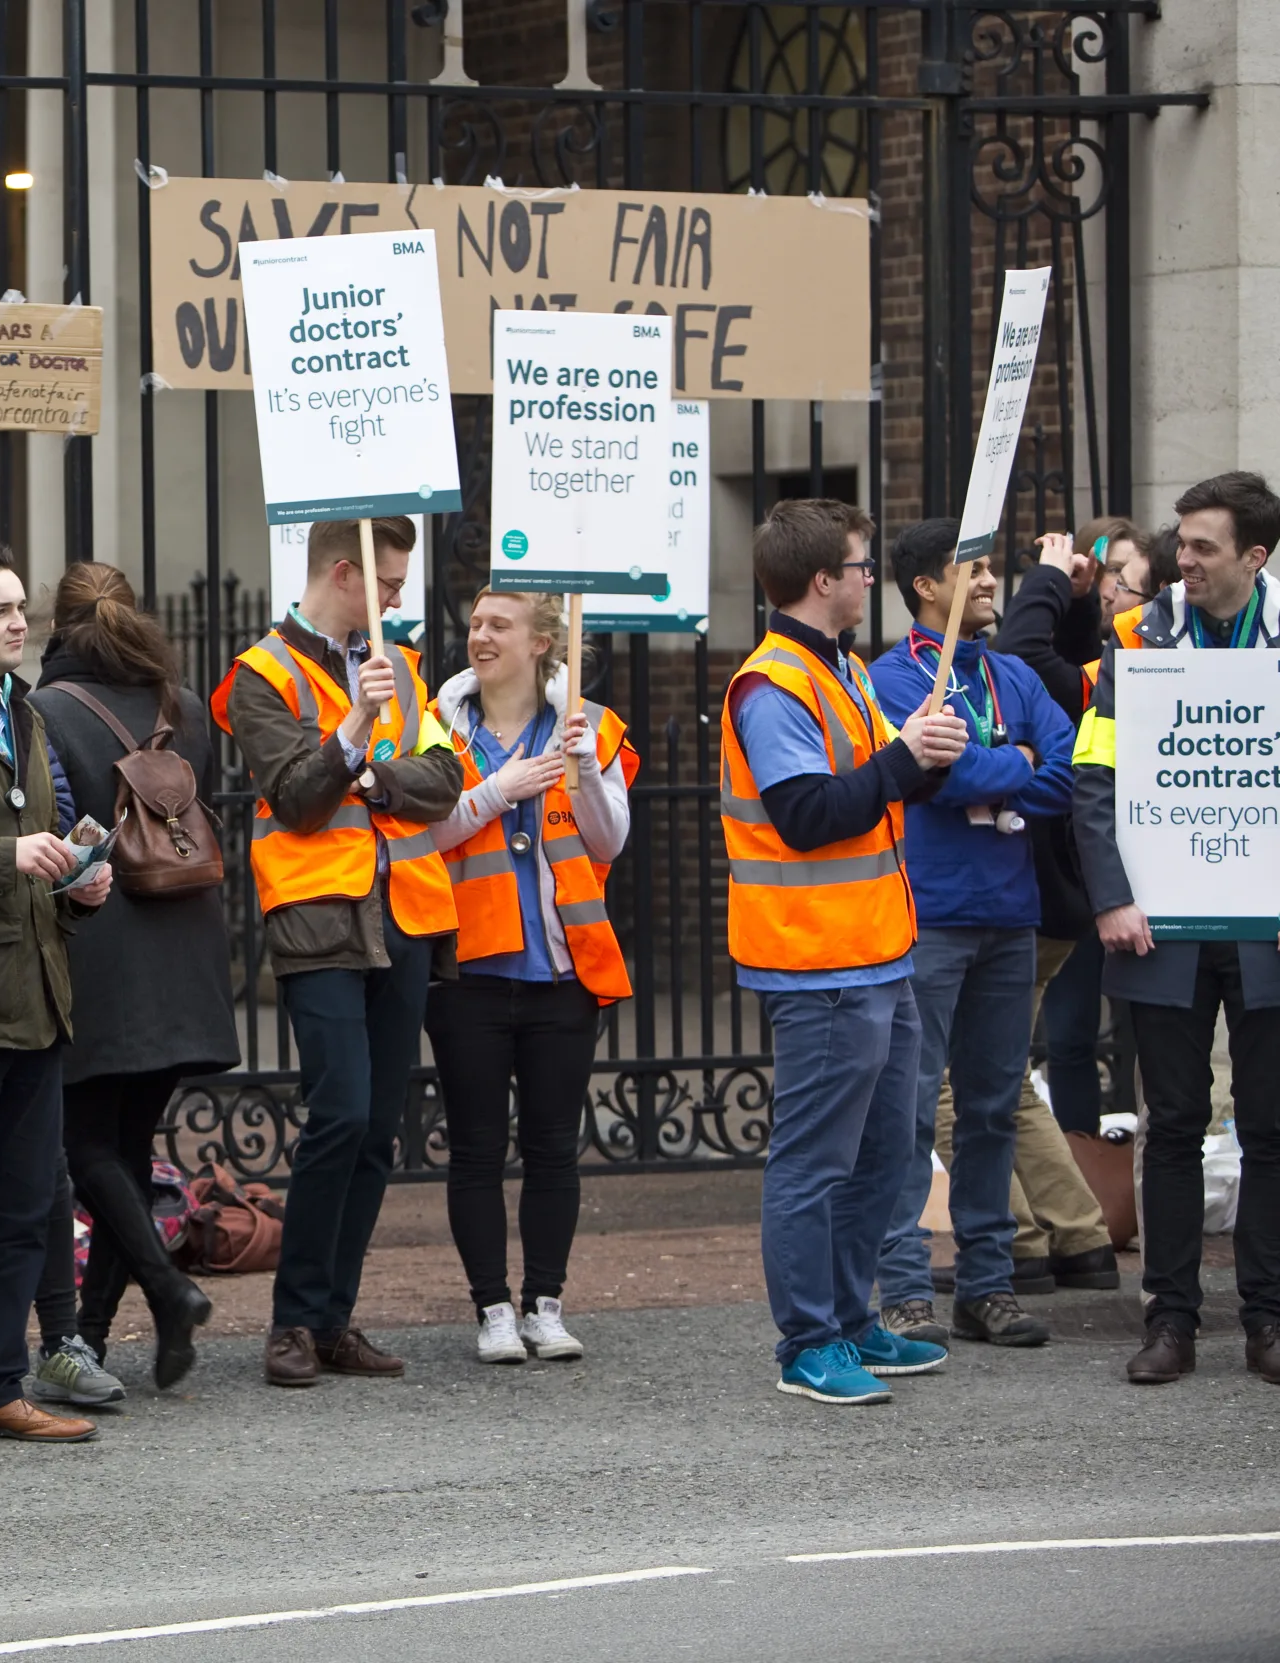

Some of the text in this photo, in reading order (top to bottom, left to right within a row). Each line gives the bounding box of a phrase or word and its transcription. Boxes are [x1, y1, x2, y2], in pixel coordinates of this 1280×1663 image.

[392, 241, 425, 255] BMA
[457, 200, 713, 291] NOT FAIR
[252, 255, 308, 267] #juniorcontract
[301, 283, 386, 315] Junior
[175, 296, 252, 376] OU
[289, 312, 403, 343] doctors'
[632, 325, 661, 339] BMA
[1001, 321, 1016, 349] We
[1015, 326, 1029, 348] are
[29, 353, 89, 373] DOCTOR
[291, 345, 411, 375] contract
[506, 358, 659, 390] We are one
[993, 353, 1033, 391] profession
[268, 377, 440, 413] It's everyone's
[509, 394, 656, 424] profession
[676, 404, 700, 415] BMA
[329, 413, 387, 445] fight
[524, 431, 638, 461] We stand
[671, 441, 699, 458] ne
[528, 466, 635, 499] together
[1127, 666, 1185, 676] #juniorcontract
[1172, 699, 1265, 729] Junior
[1157, 731, 1280, 757] doctors'
[1155, 765, 1280, 789] contract
[1129, 799, 1162, 826] It's
[1189, 831, 1251, 864] fight
[1154, 923, 1182, 931] profession
